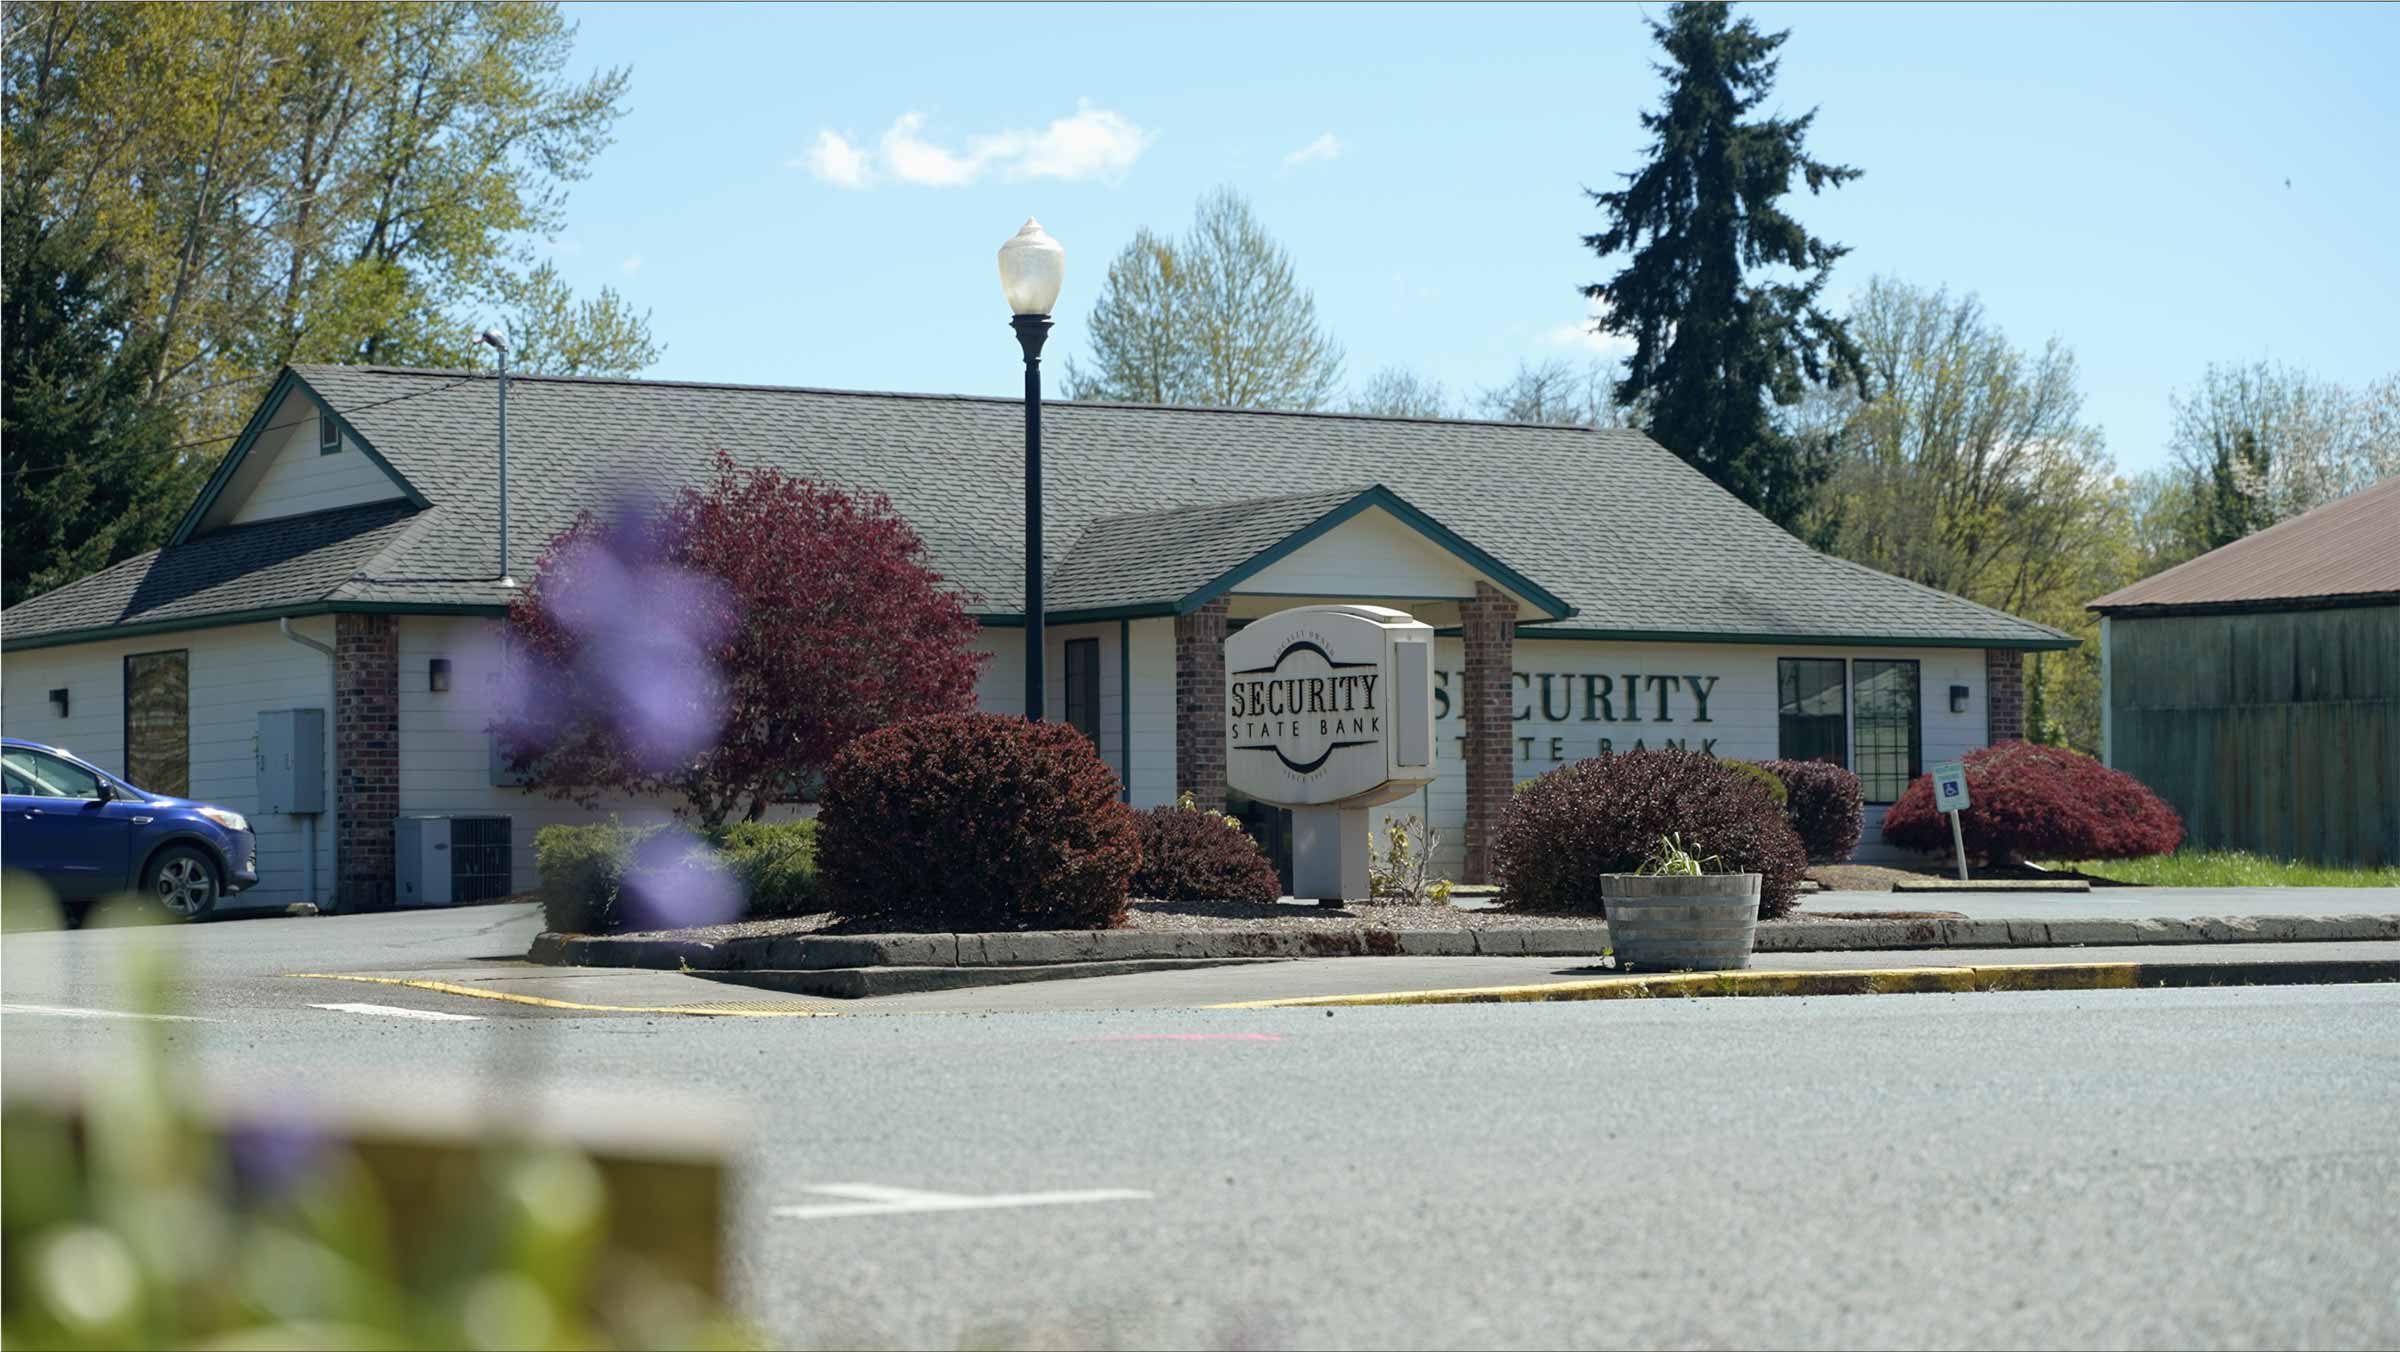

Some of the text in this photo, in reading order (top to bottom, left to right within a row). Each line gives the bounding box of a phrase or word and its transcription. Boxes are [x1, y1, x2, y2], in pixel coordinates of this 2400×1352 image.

[1231, 674, 1378, 717] SECURITY
[1435, 670, 1720, 722] SCURITY
[1232, 717, 1380, 739] STATE BANK
